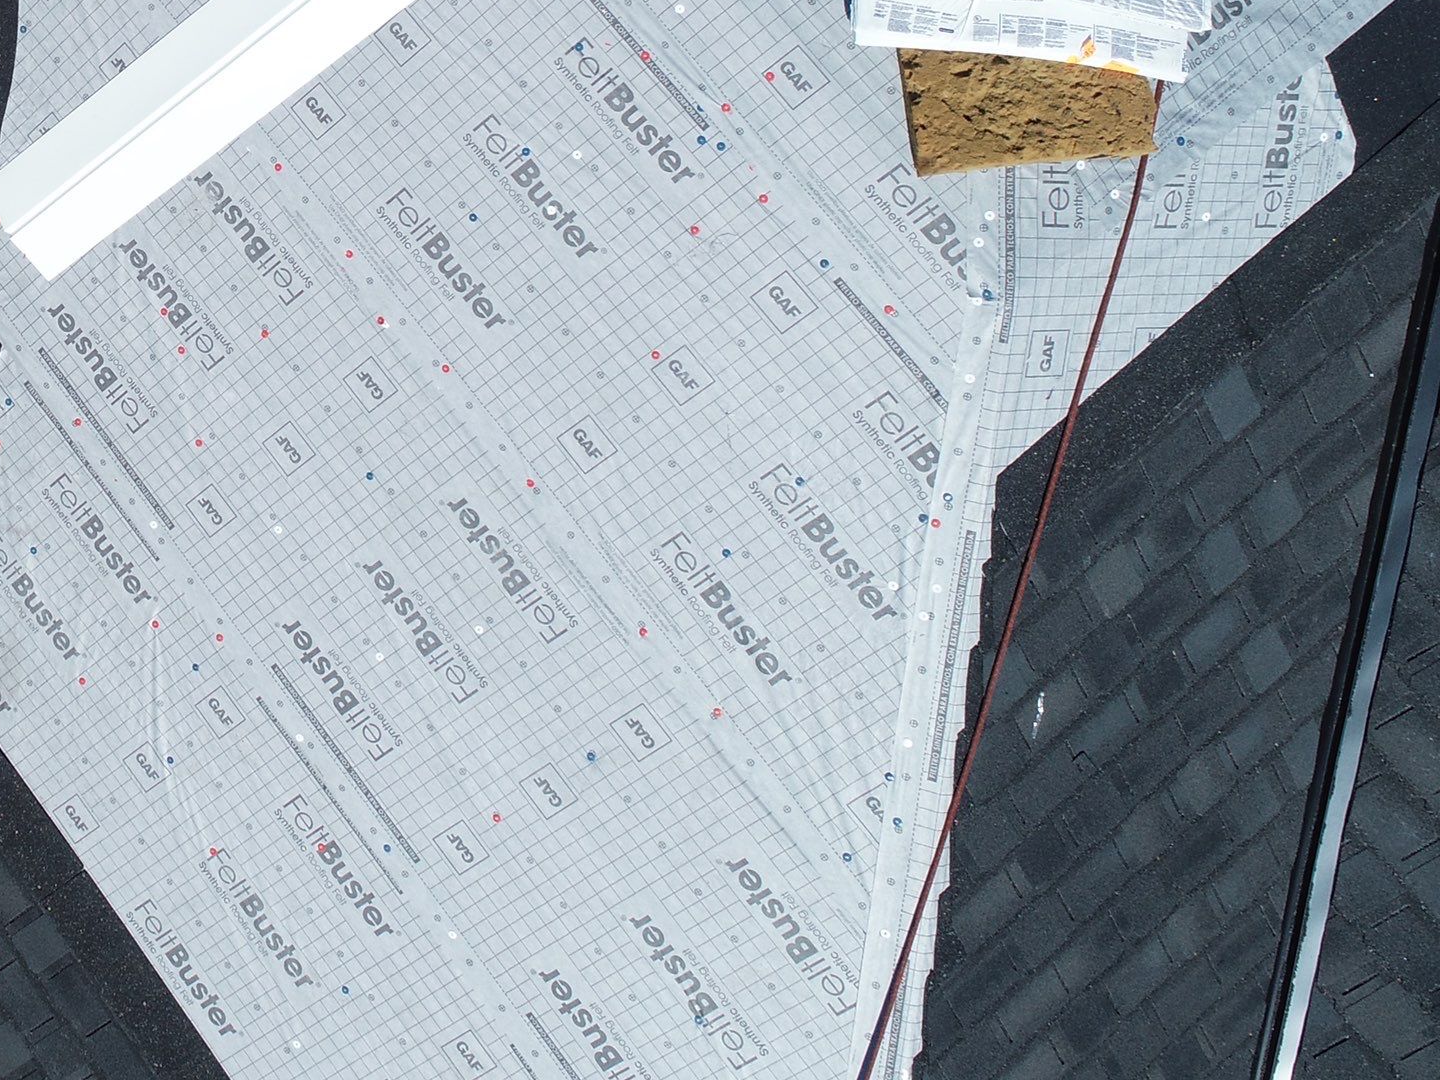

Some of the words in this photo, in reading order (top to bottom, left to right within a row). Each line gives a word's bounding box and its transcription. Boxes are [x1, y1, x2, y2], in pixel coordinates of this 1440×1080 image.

[389, 21, 418, 52] GAF
[612, 21, 629, 39] CON
[779, 59, 813, 95] GAF
[305, 96, 334, 126] GAF
[551, 55, 596, 103] Synthetic
[588, 99, 626, 140] Roofing
[621, 135, 641, 156] Felt
[583, 35, 696, 183] FeltBuster
[1297, 104, 1308, 124] Felt
[460, 131, 503, 179] Synthetic
[496, 175, 532, 215] Roofing
[527, 210, 546, 230] Felt
[491, 113, 599, 258] FeltBuster
[1179, 173, 1198, 229] Synthetic
[237, 196, 255, 215] Felt
[1005, 196, 1014, 214] CON
[191, 170, 287, 306] FeltBuster
[250, 210, 282, 248] Roofing
[861, 182, 911, 235] Synthetic
[939, 269, 962, 292] Felt
[161, 263, 177, 282] Felt
[276, 244, 314, 289] Synthetic
[373, 204, 415, 251] Synthetic
[408, 247, 442, 286] Roofing
[438, 282, 456, 302] Felt
[403, 186, 507, 329] FeltBuster
[1005, 250, 1014, 270] PARA
[116, 238, 208, 371] FeltBuster
[173, 278, 204, 314] Roofing
[767, 284, 802, 320] GAF
[88, 328, 103, 346] Felt
[198, 311, 234, 355] Synthetic
[1039, 334, 1054, 372] GAF
[45, 302, 133, 434] FeltBuster
[99, 342, 129, 378] Roofing
[668, 359, 700, 392] GAF
[123, 375, 158, 418] Synthetic
[356, 369, 385, 401] GAF
[273, 434, 302, 465] GAF
[572, 428, 603, 461] GAF
[850, 408, 898, 461] Synthetic
[39, 486, 74, 530] Synthetic
[69, 527, 98, 563] Roofing
[94, 559, 110, 577] Felt
[197, 496, 224, 526] GAF
[63, 472, 152, 603] FeltBuster
[495, 526, 514, 546] Felt
[745, 479, 793, 531] Synthetic
[784, 528, 824, 571] Roofing
[819, 567, 840, 588] Felt
[781, 462, 898, 620] FeltBuster
[444, 496, 548, 644] FeltBuster
[509, 542, 545, 582] Roofing
[0, 584, 28, 620] Roofing
[25, 616, 40, 634] Felt
[409, 589, 427, 608] Felt
[537, 580, 579, 628] Synthetic
[647, 546, 692, 597] Synthetic
[684, 594, 722, 637] Roofing
[717, 633, 737, 654] Felt
[680, 530, 793, 685] FeltBuster
[360, 559, 460, 704] FeltBuster
[422, 605, 456, 644] Roofing
[326, 648, 344, 667] Felt
[449, 641, 489, 689] Synthetic
[928, 751, 940, 779] FIELTRO
[938, 695, 948, 714] PARA
[946, 646, 956, 664] CON
[959, 532, 975, 586] INCORPORADA
[279, 619, 376, 761] FeltBuster
[339, 664, 372, 703] Roofing
[207, 697, 234, 728] GAF
[365, 700, 404, 747] Synthetic
[626, 717, 656, 750] GAF
[135, 752, 160, 784] GAF
[533, 774, 562, 807] GAF
[64, 804, 90, 834] GAF
[272, 806, 310, 853] Synthetic
[303, 851, 335, 890] Roofing
[331, 887, 348, 906] Felt
[299, 793, 394, 936] FeltBuster
[446, 831, 475, 864] GAF
[196, 859, 233, 905] Synthetic
[227, 903, 257, 941] Roofing
[253, 939, 270, 957] Felt
[222, 846, 314, 987] FeltBuster
[779, 890, 800, 911] Felt
[124, 909, 159, 955] Synthetic
[153, 953, 183, 990] Roofing
[179, 988, 195, 1006] Felt
[681, 947, 701, 968] Felt
[722, 857, 837, 1015] FeltBuster
[149, 898, 237, 1036] FeltBuster
[696, 965, 733, 1008] Roofing
[588, 1001, 606, 1021] Felt
[626, 914, 737, 1070] FeltBuster
[725, 1006, 770, 1057] Synthetic
[455, 1040, 484, 1071] GAF
